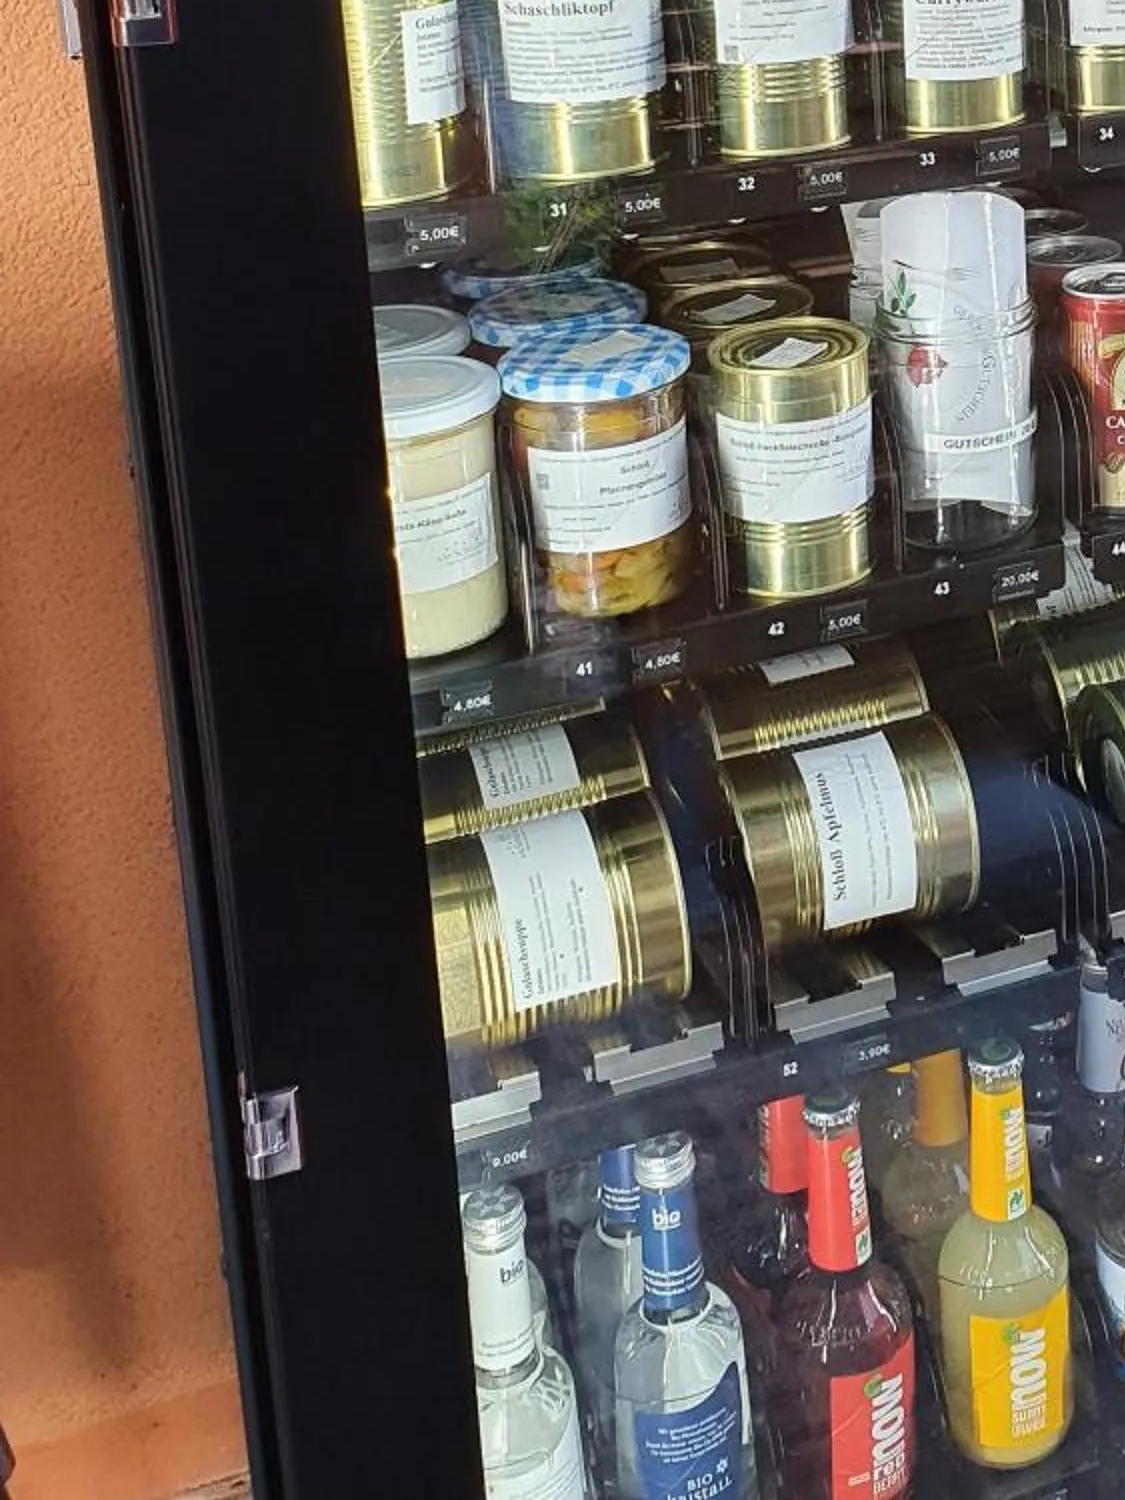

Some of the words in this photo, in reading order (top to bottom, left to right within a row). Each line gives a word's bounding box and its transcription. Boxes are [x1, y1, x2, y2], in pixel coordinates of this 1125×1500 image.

[1099, 126, 1114, 141] 34
[919, 151, 936, 167] 33
[738, 176, 755, 191] 32
[550, 202, 567, 217] 31
[625, 198, 661, 213] 5,00€
[420, 225, 459, 241] 5,00€
[943, 430, 1017, 449] GUTSCHEIN
[1001, 571, 1040, 587] 20,00€
[934, 581, 950, 596] 43
[767, 621, 785, 636] 42
[575, 661, 593, 677] 41
[783, 1061, 799, 1076] 52
[651, 1205, 681, 1230] bio
[500, 1258, 525, 1284] bio
[687, 1473, 713, 1492] BIO
